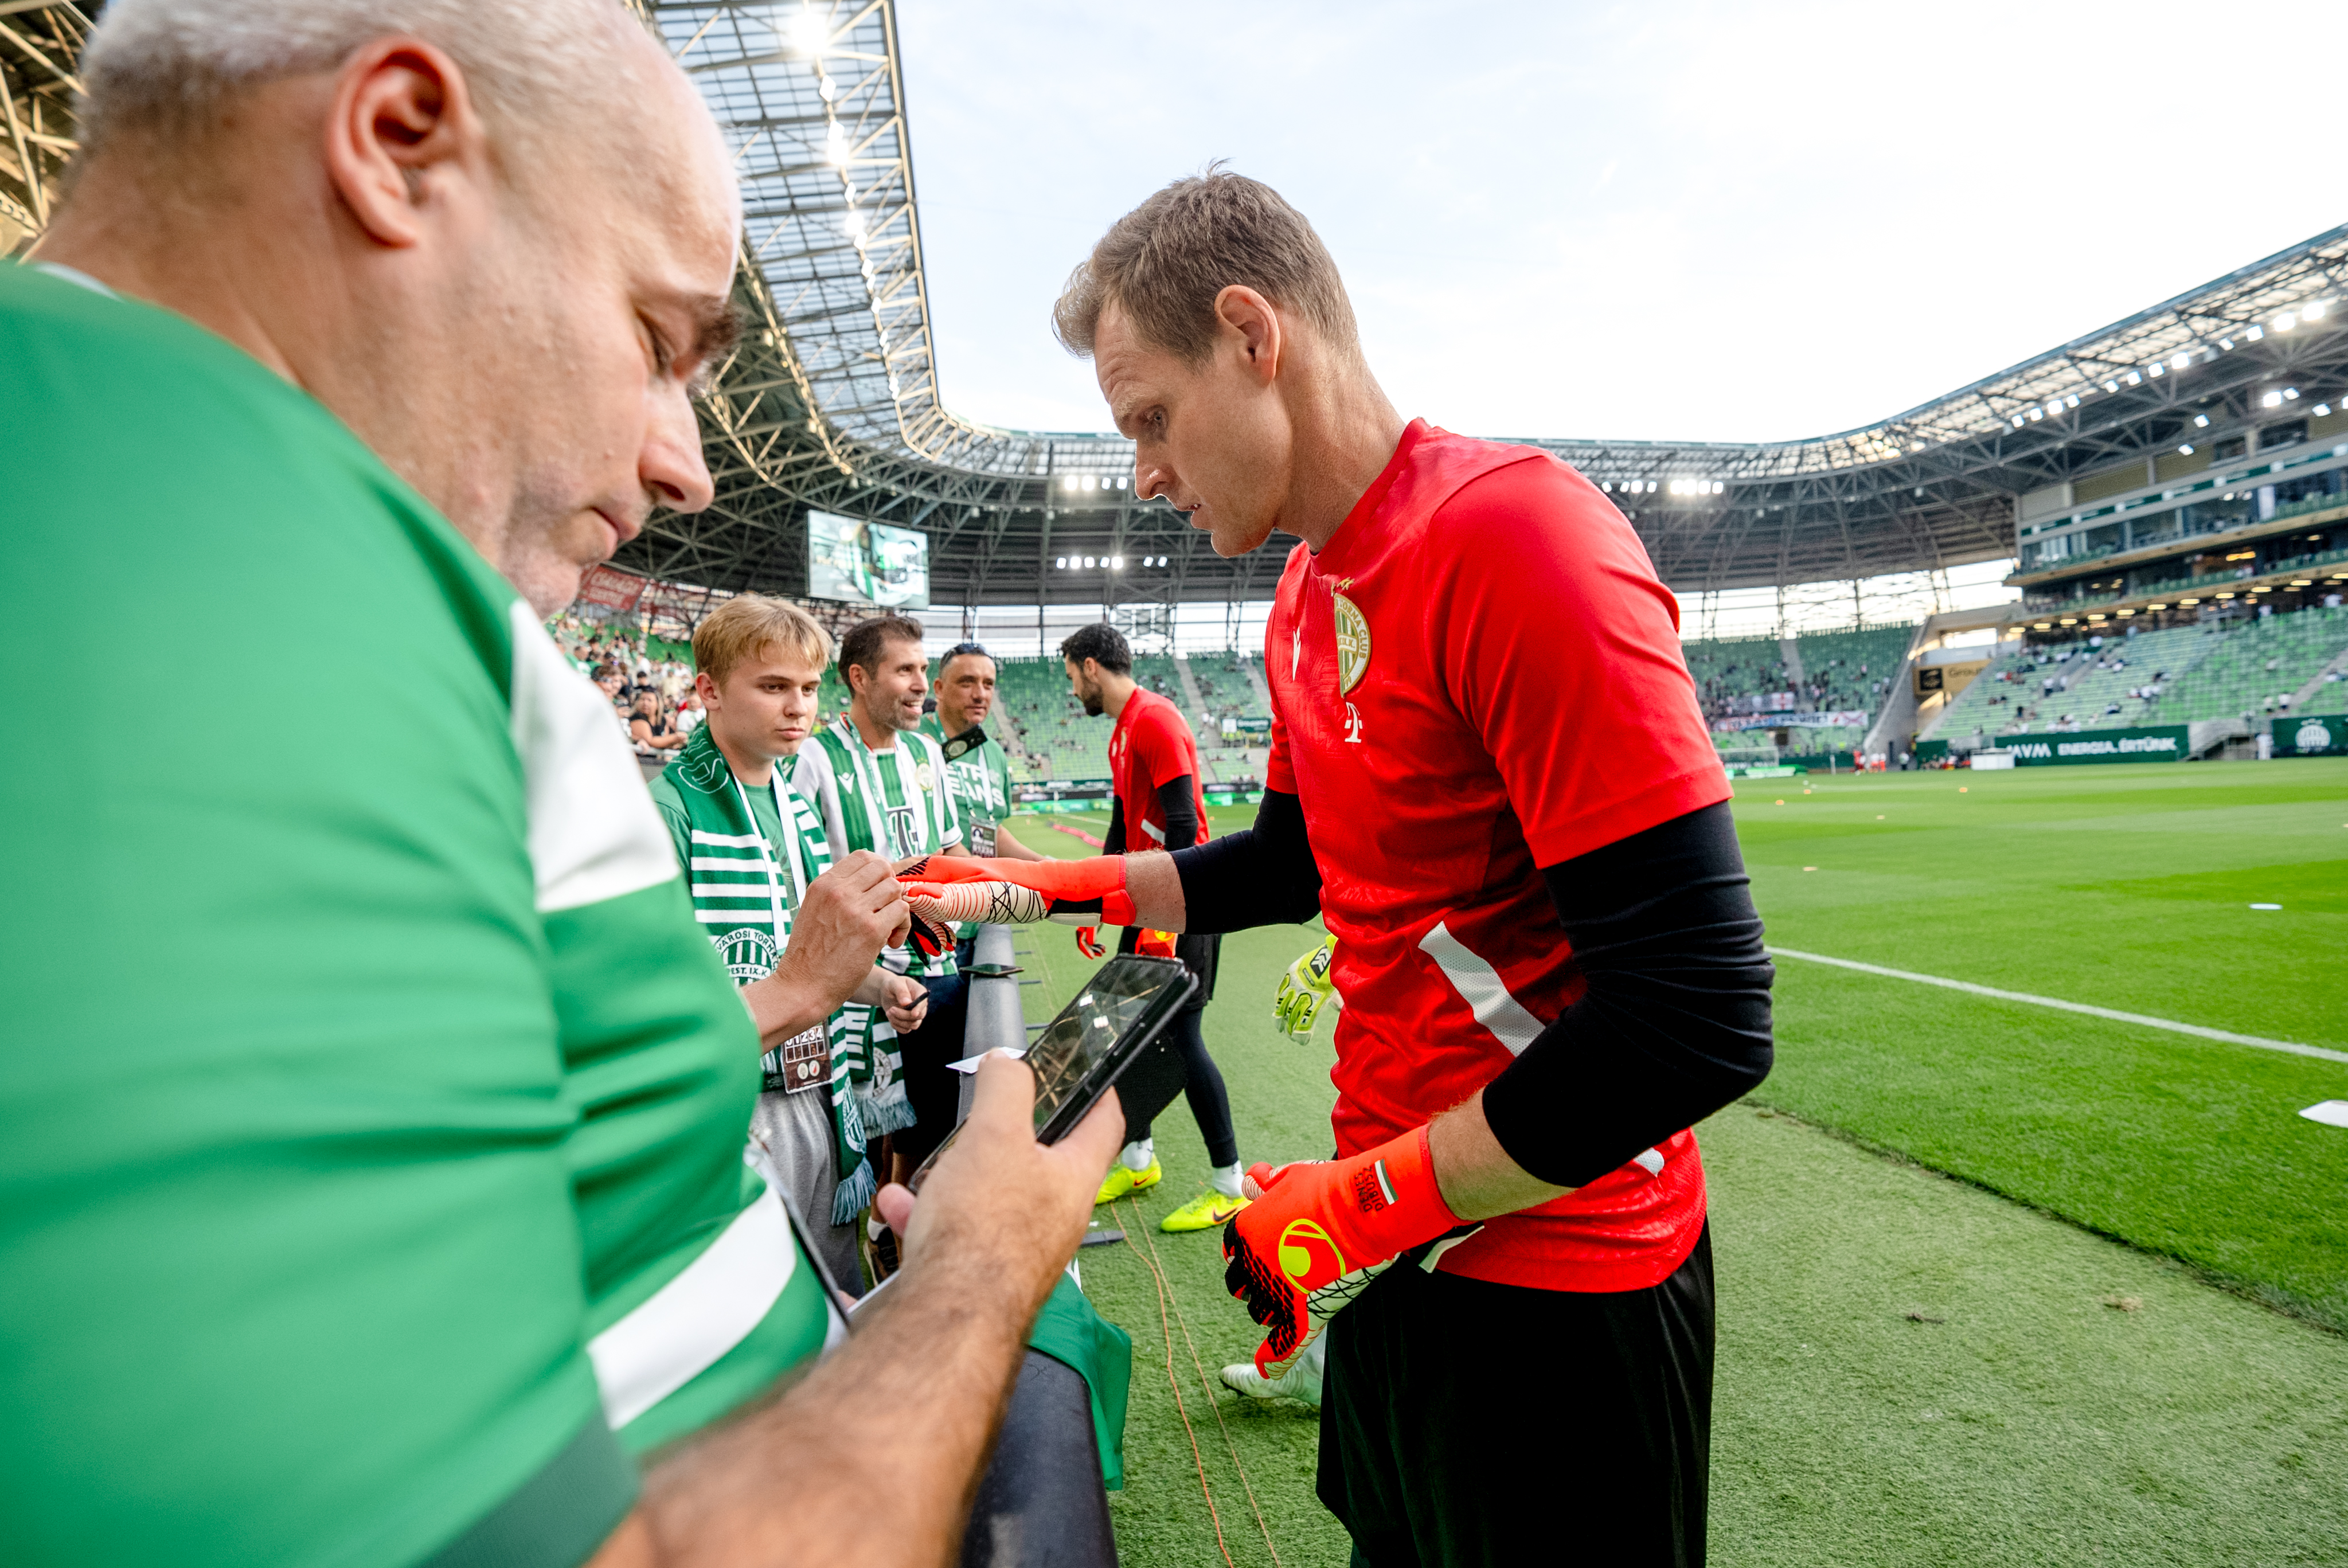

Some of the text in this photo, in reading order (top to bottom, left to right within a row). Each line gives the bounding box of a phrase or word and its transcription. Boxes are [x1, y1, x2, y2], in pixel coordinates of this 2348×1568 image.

[1359, 629, 1367, 659] CLUB
[948, 777, 1006, 807] EANS
[716, 930, 751, 952] VÁROSI
[754, 932, 777, 959] TORNA
[1364, 1166, 1384, 1212] DIBUSZ
